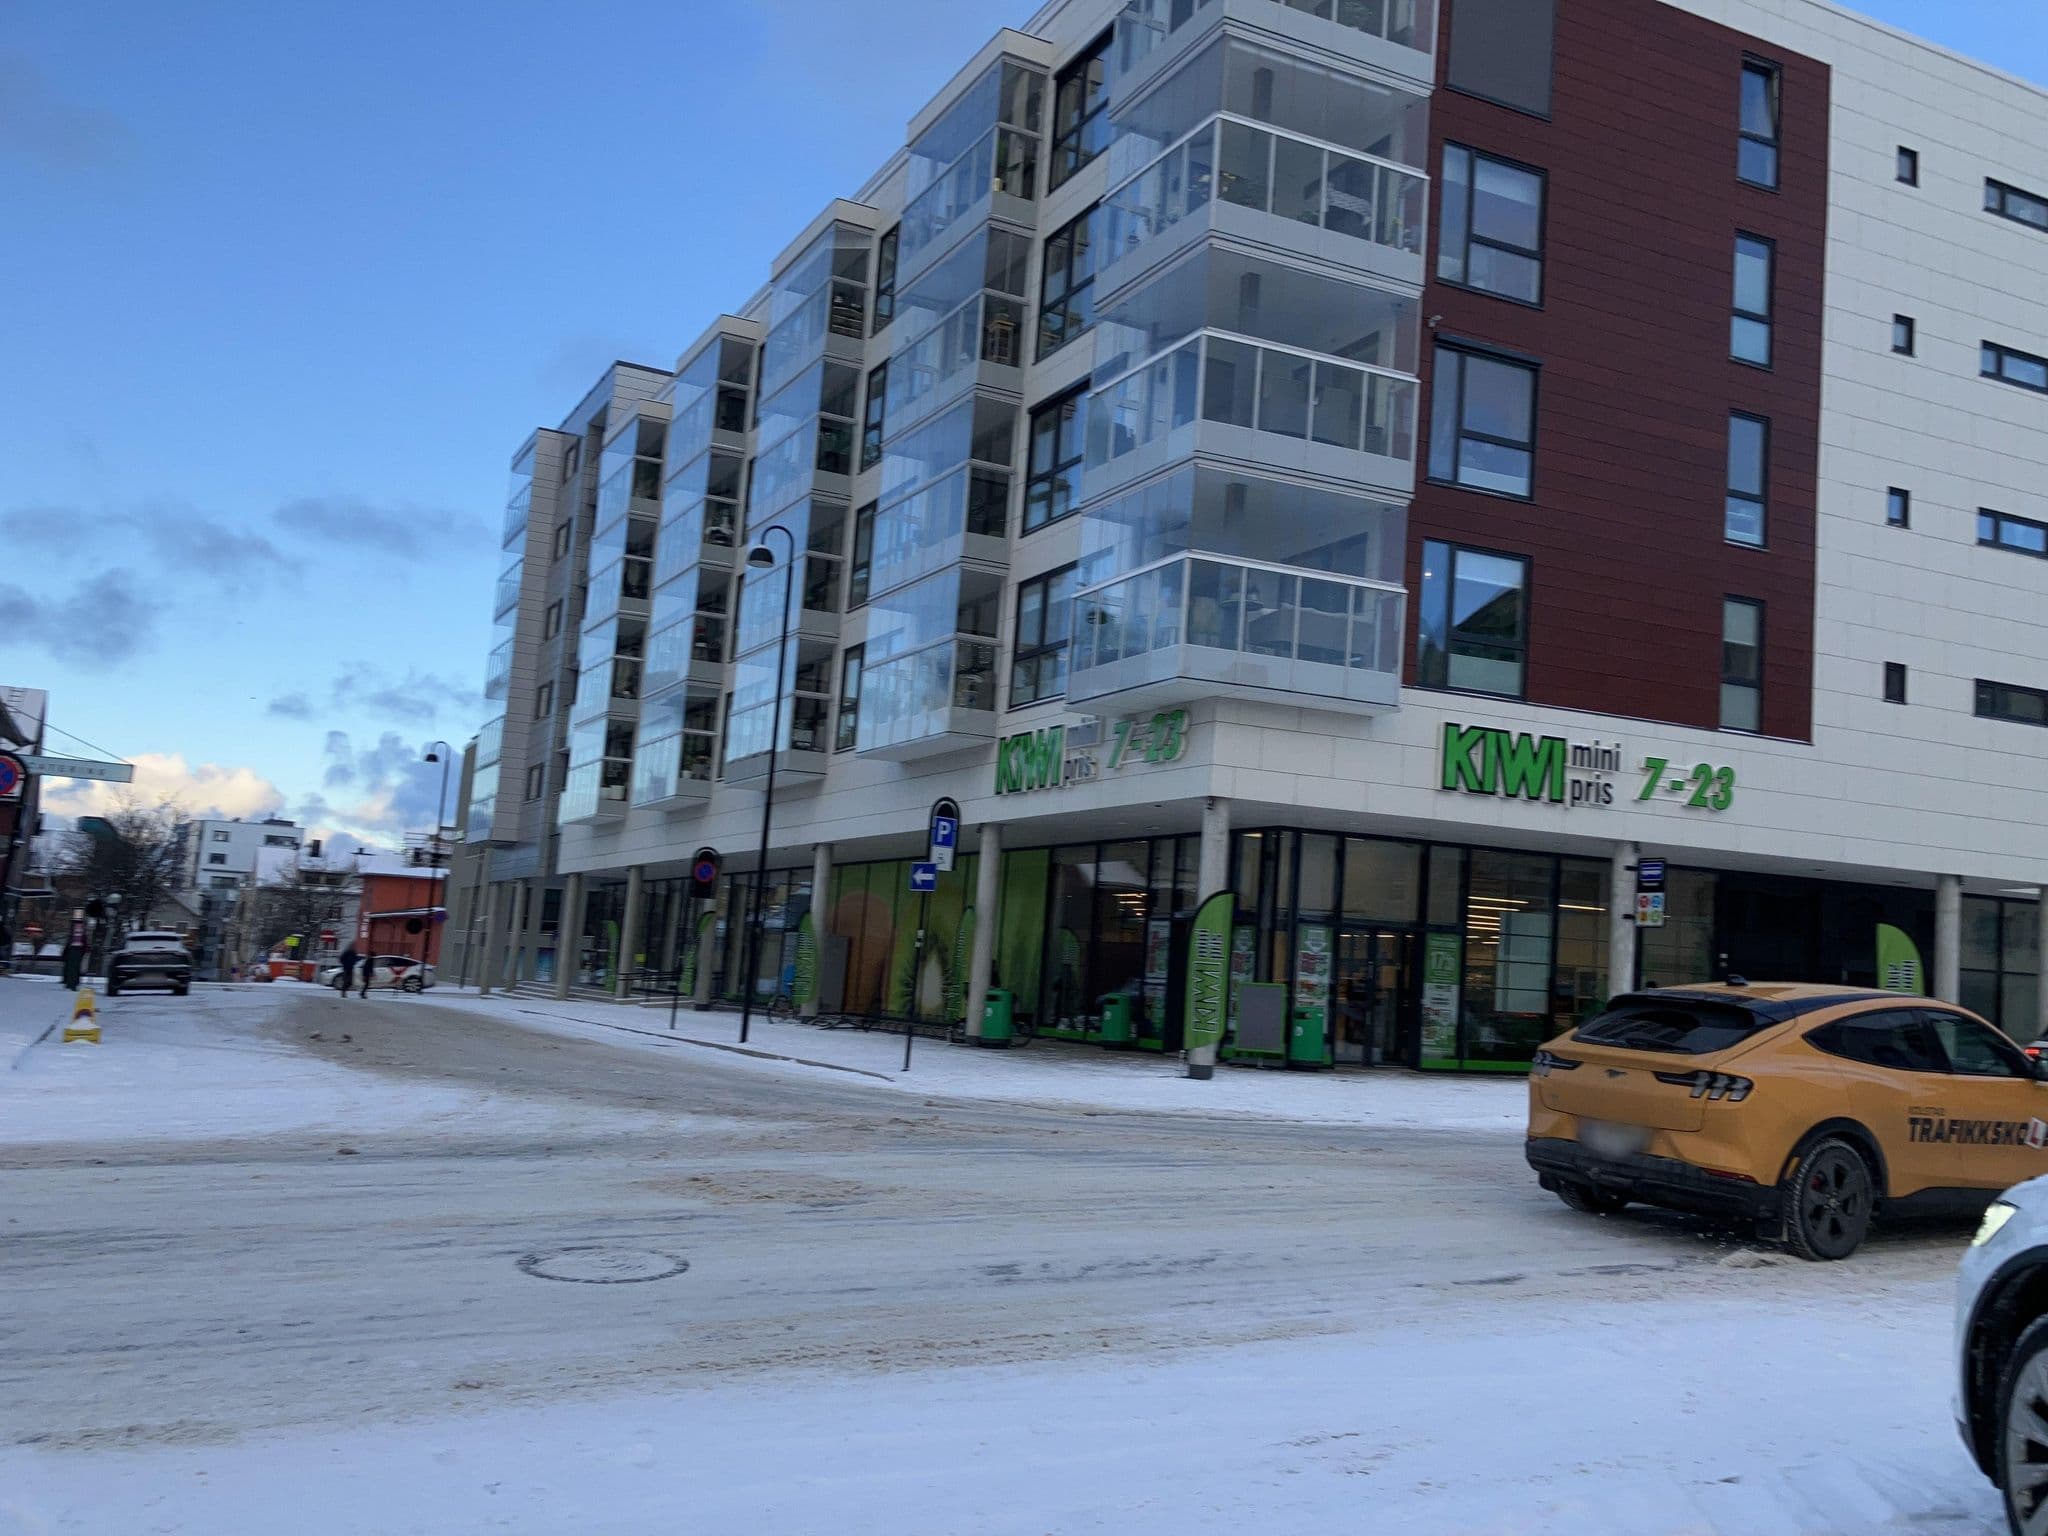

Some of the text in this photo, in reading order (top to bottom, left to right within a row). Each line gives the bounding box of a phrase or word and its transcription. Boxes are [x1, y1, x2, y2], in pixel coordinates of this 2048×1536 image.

[995, 725, 1065, 795] KIWI
[1442, 721, 1567, 803] KIWI
[1571, 740, 1622, 772] mini
[1636, 756, 1735, 811] 7-23
[1570, 773, 1614, 807] pris
[936, 821, 952, 843] P
[1191, 960, 1223, 1034] KIWI
